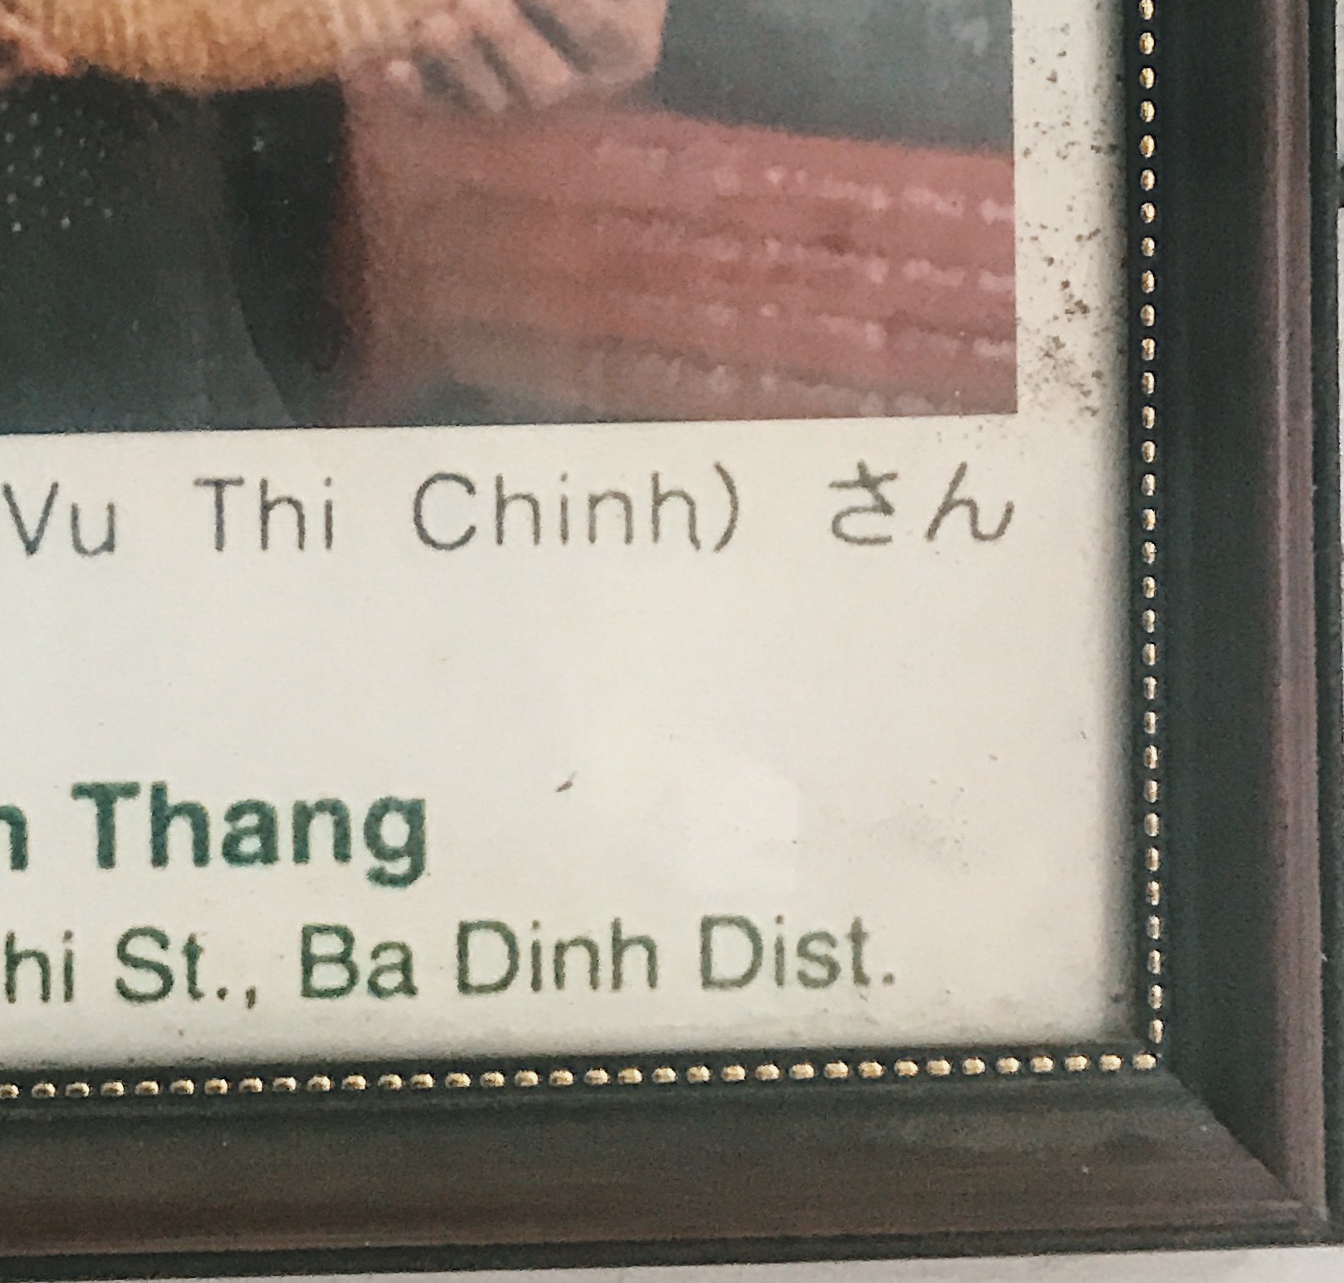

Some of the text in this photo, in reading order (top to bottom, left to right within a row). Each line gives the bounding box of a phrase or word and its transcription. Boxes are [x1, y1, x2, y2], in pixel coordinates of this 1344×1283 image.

[193, 476, 334, 553] Thi
[829, 461, 1015, 546] さん
[70, 780, 427, 890] Thang
[114, 926, 258, 1011] St.,
[299, 923, 419, 1001] Ba
[455, 918, 659, 997] Dinh
[699, 915, 895, 991] Dist.
